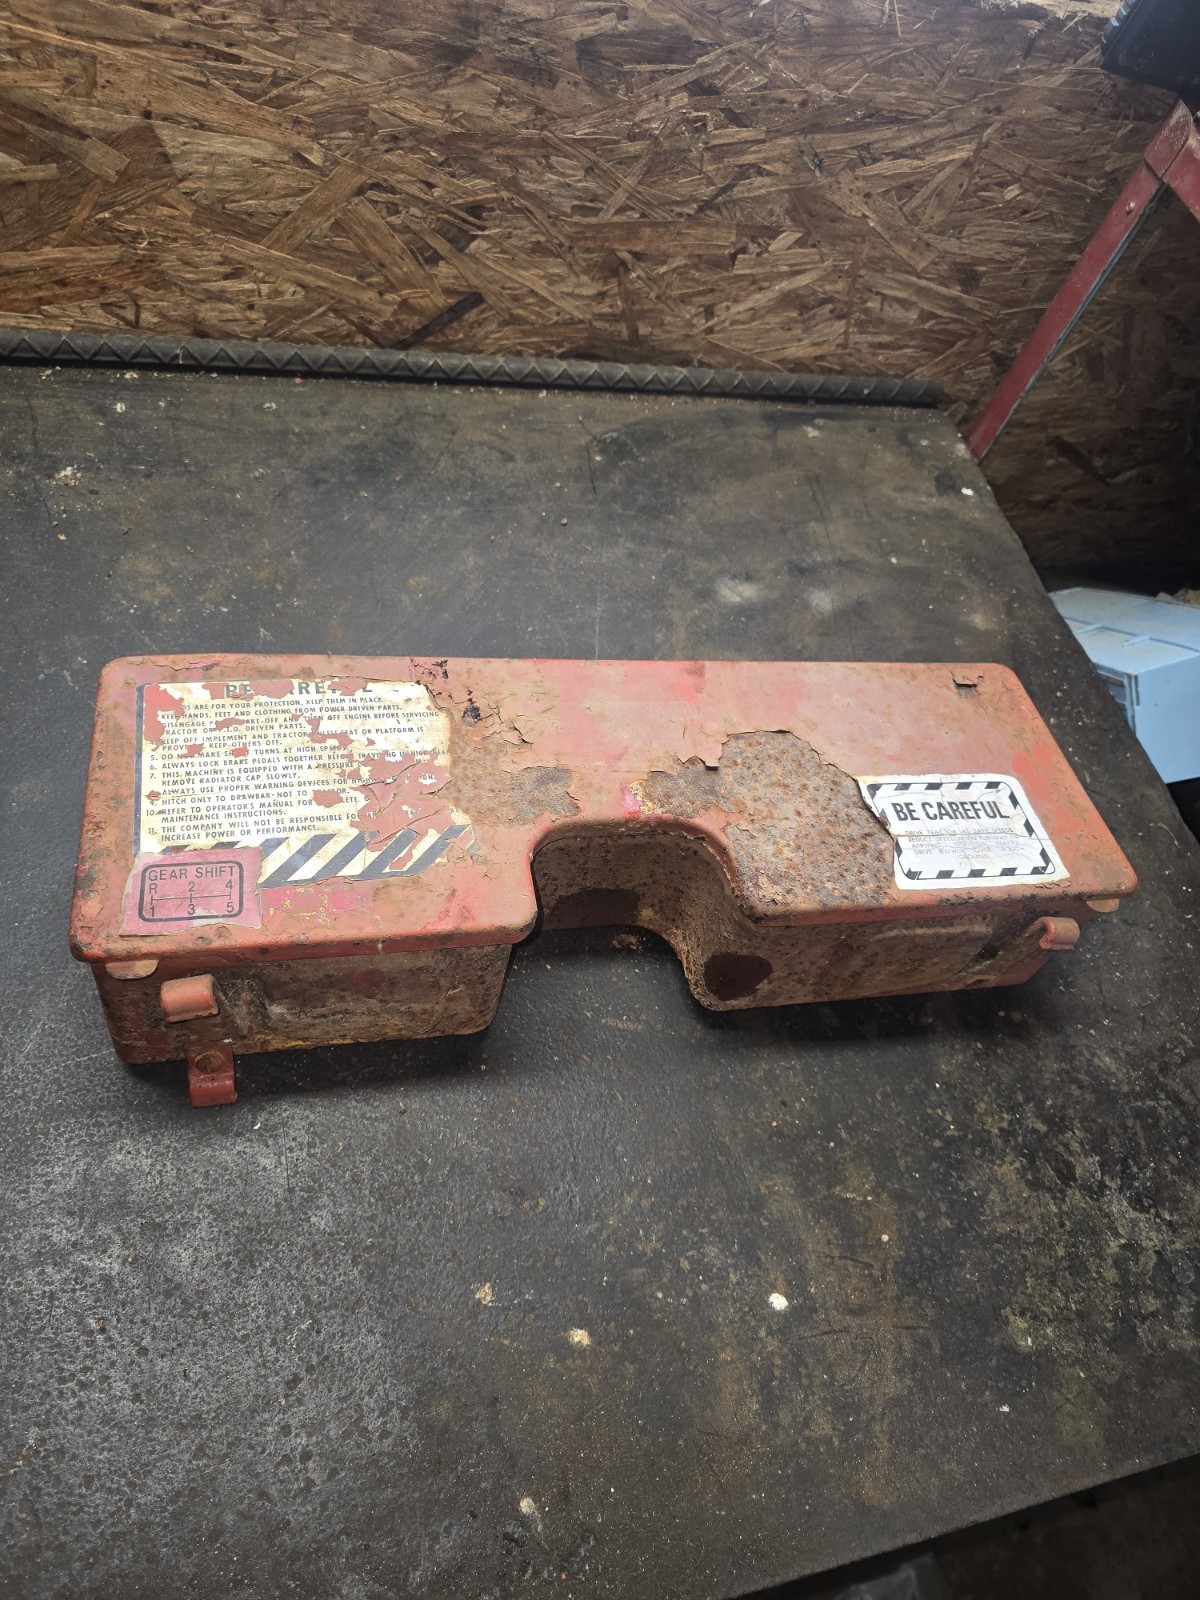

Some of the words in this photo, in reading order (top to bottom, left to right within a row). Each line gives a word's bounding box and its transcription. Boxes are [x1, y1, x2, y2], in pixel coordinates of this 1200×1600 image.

[254, 700, 304, 708] PROTECTION,
[206, 803, 254, 812] OPERATOR'S
[891, 803, 921, 821] BE
[921, 801, 1010, 820] CAREFUL
[162, 814, 219, 823] MAINTENANCE
[225, 810, 285, 818] INSTRUCTIONS.
[181, 823, 222, 831] COMPANY
[290, 814, 342, 823] RESPONSIBLE
[257, 825, 318, 835] PERFORMANCE.
[149, 869, 187, 881] GEAR
[195, 866, 235, 878] SHIFT
[149, 883, 157, 894] R
[188, 882, 195, 892] 2
[226, 880, 233, 890] 4
[150, 906, 155, 917] 1
[188, 904, 195, 915] 3
[227, 902, 234, 913] 5
